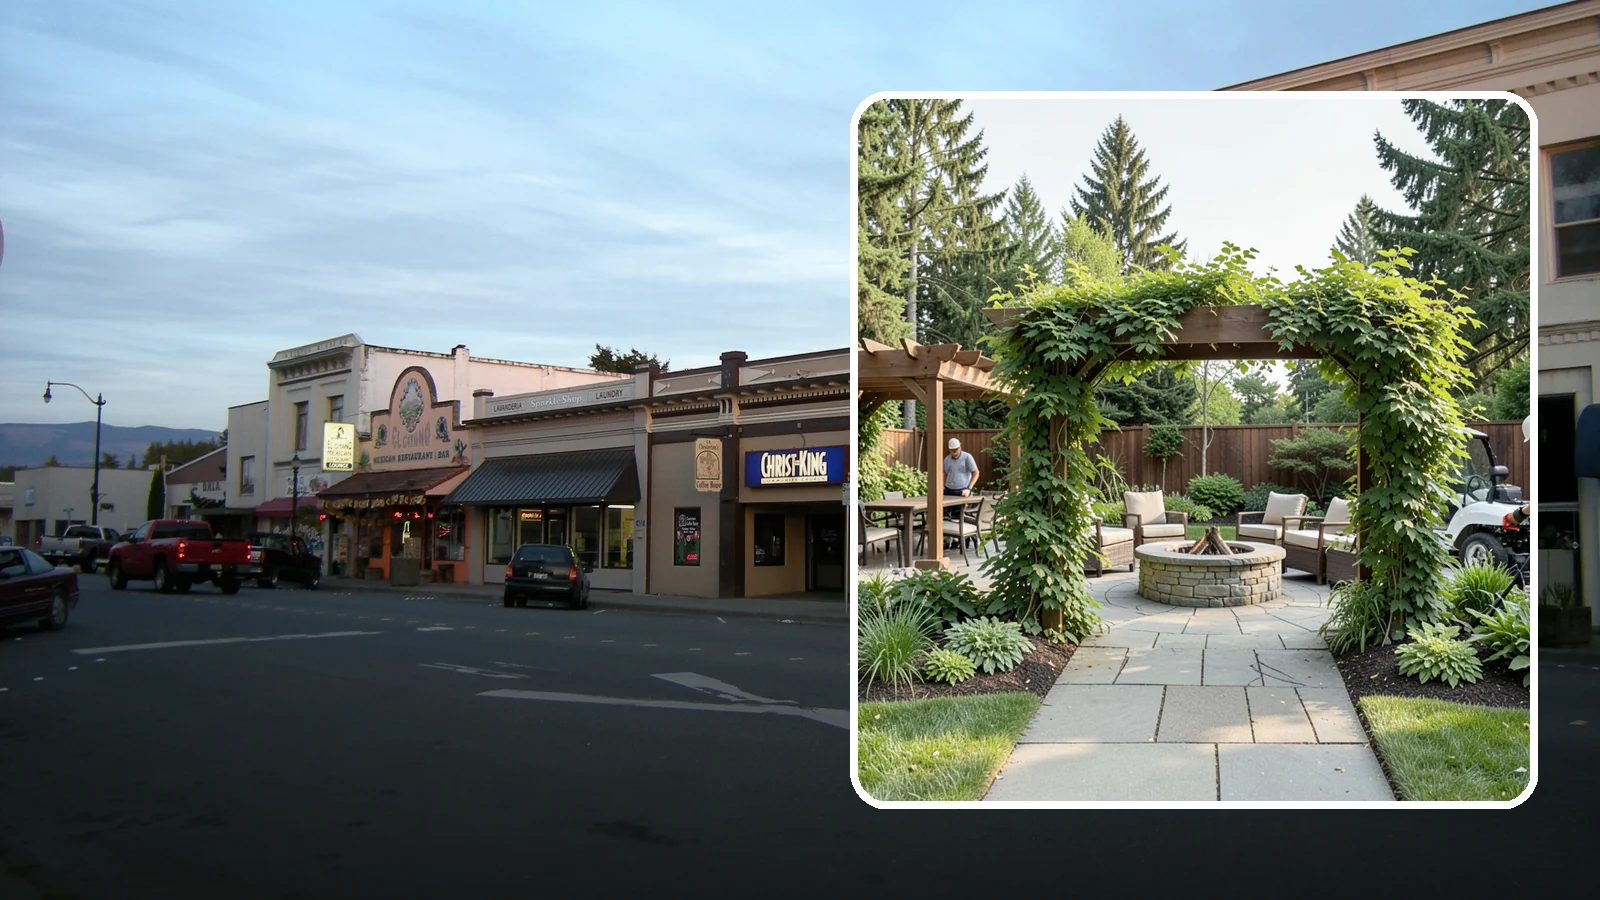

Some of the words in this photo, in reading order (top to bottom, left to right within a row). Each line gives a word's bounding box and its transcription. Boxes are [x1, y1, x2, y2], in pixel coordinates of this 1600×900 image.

[562, 394, 582, 405] Shop
[596, 389, 624, 400] LAUNDRY
[493, 402, 522, 412] LAVANDERIA
[374, 454, 396, 464] MEXICAN
[398, 451, 433, 462] RESTAURANT
[438, 450, 450, 459] BAR
[760, 452, 797, 478] CHRIST
[798, 450, 828, 477] KING
[696, 481, 709, 489] Coffee
[710, 481, 722, 489] House
